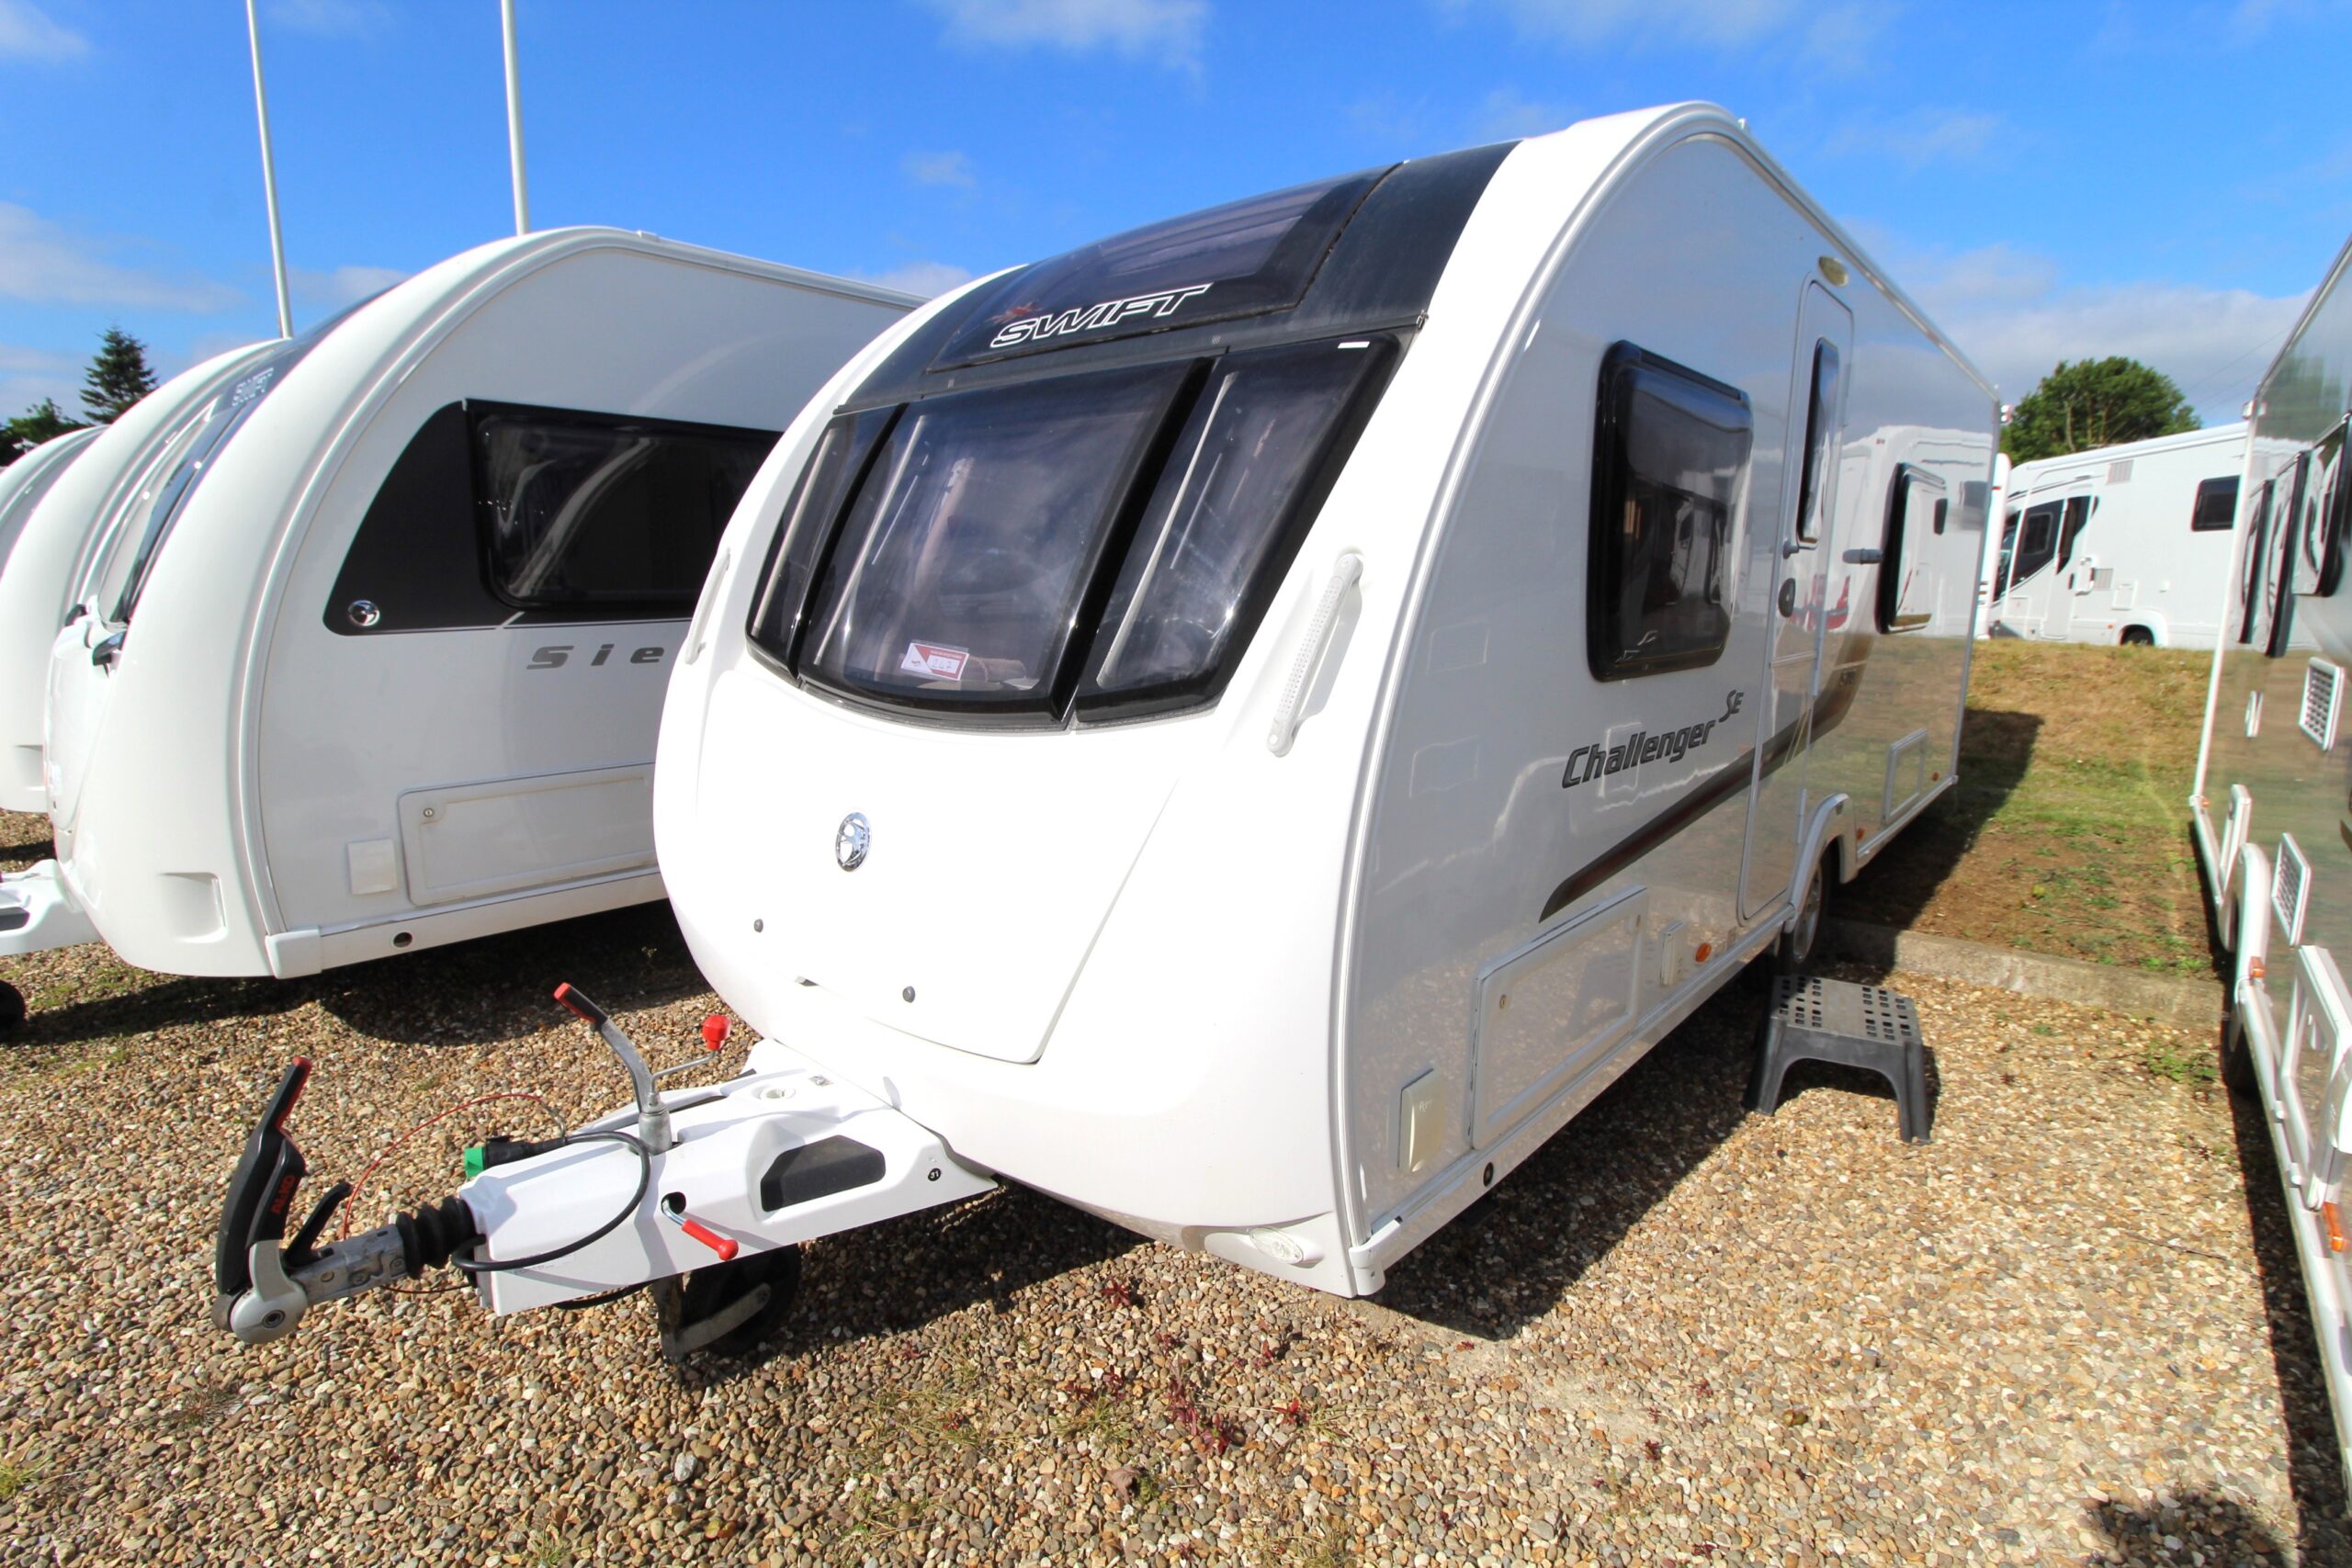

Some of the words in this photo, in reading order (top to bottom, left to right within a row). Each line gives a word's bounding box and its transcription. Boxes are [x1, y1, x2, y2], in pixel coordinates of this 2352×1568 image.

[989, 282, 1214, 348] SWIFT
[1562, 720, 1716, 788] Challenger
[1718, 690, 1744, 723] SE
